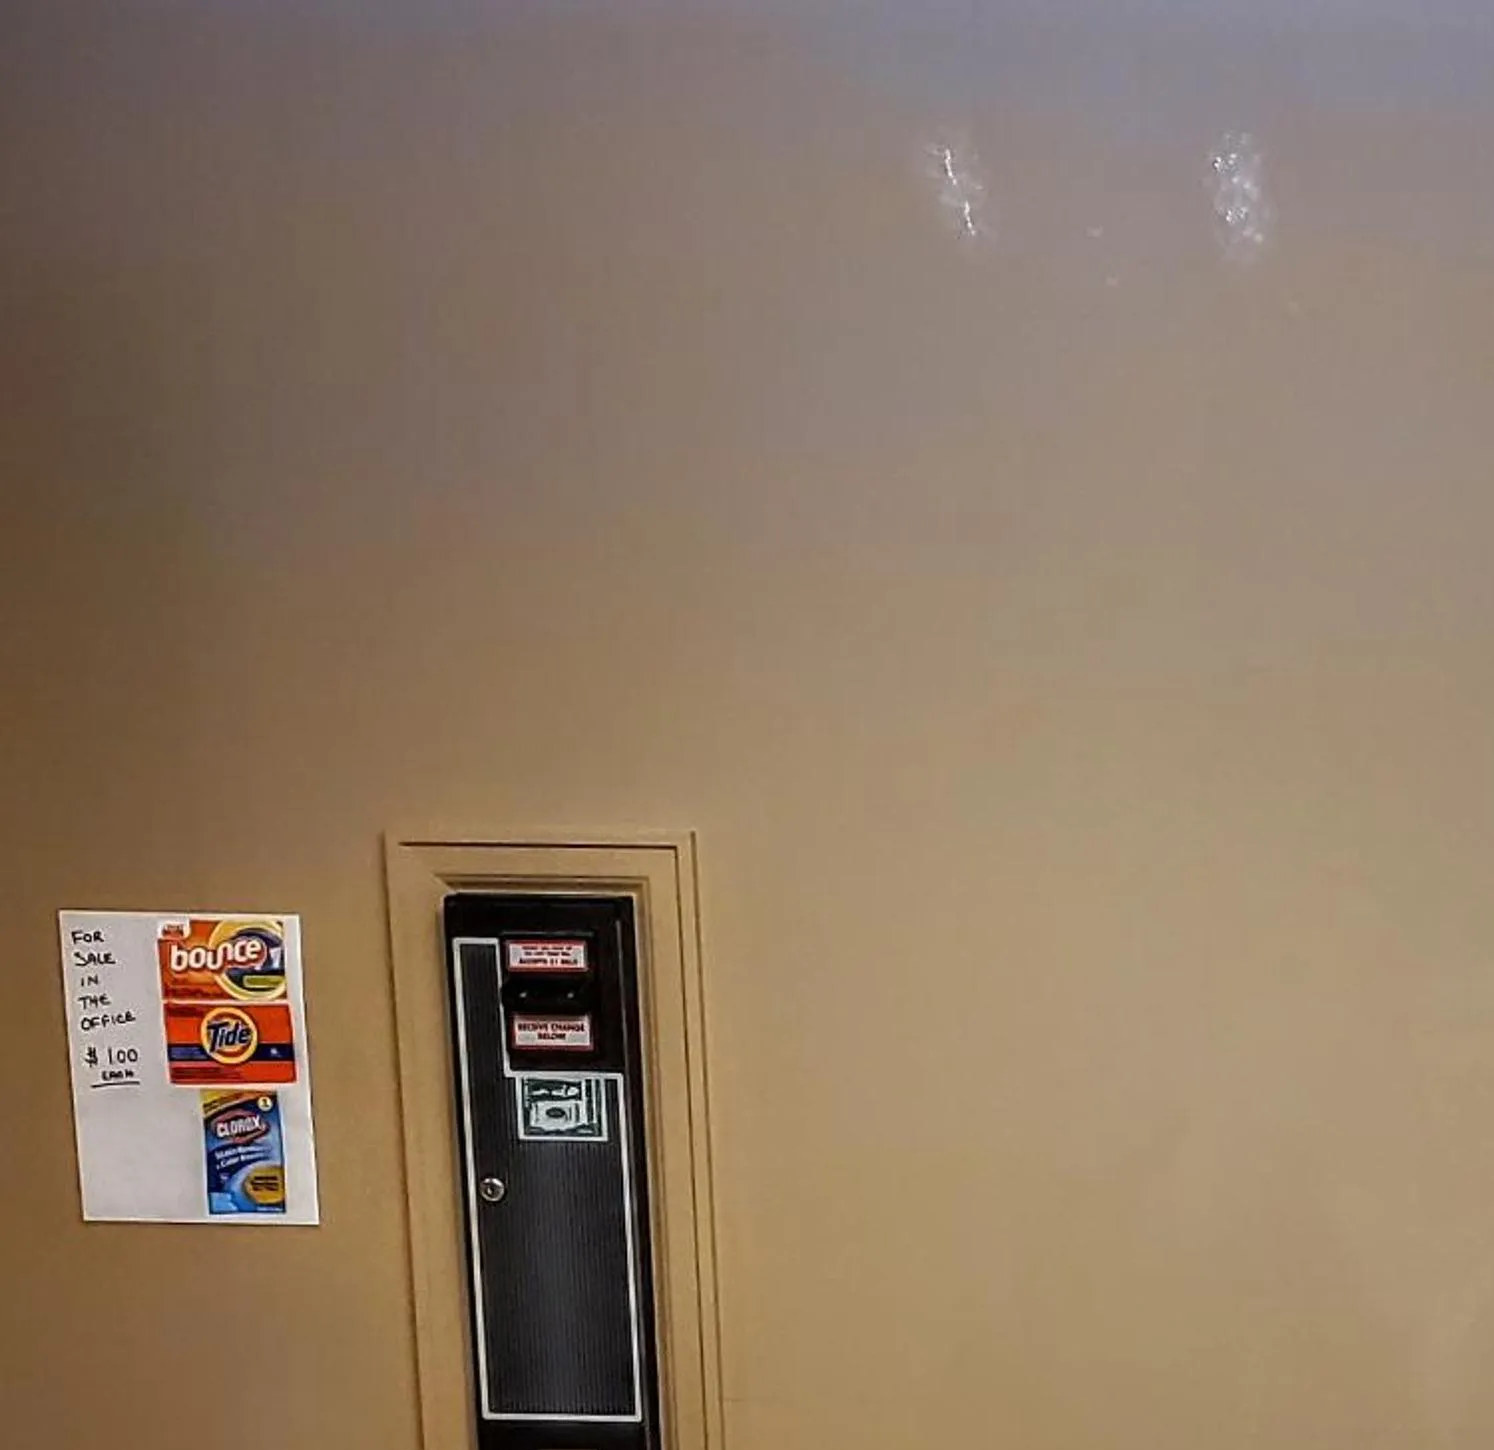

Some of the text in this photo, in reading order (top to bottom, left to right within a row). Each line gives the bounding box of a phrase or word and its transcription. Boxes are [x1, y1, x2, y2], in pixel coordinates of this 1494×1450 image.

[71, 930, 104, 945] FOR
[73, 952, 116, 967] SALE
[170, 939, 262, 971] bounce
[81, 975, 99, 987] IN
[77, 993, 111, 1010] THE
[80, 1011, 136, 1031] OFFICE
[551, 1022, 585, 1032] CHANGE
[206, 1020, 254, 1053] Tide
[537, 1032, 566, 1040] BELOW
[216, 1115, 261, 1137] CLOROX
